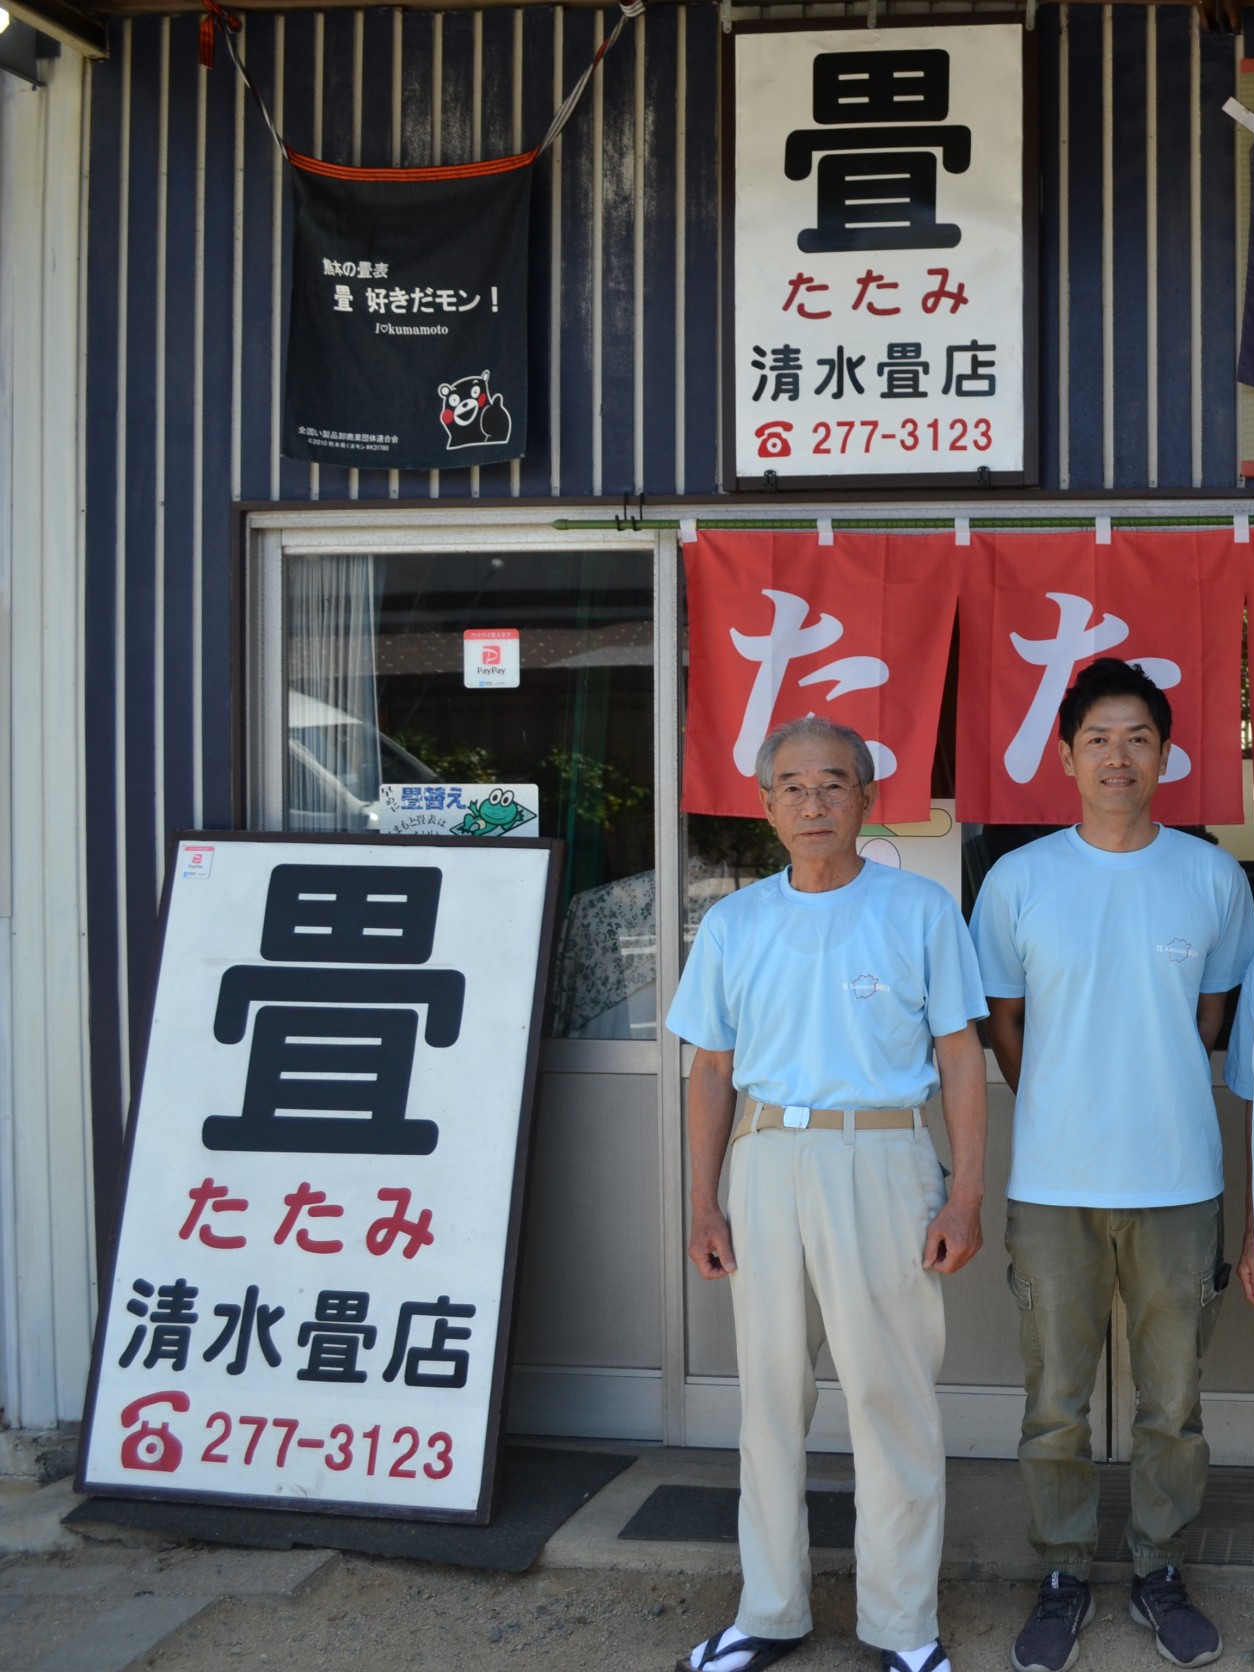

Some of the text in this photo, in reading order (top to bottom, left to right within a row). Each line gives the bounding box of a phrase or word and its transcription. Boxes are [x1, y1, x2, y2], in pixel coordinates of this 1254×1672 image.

[784, 49, 971, 253] 畳
[323, 257, 389, 279] 熊本の畳表
[782, 268, 969, 320] たたみ
[334, 285, 354, 312] 畳
[751, 340, 997, 401] 清水畳店
[812, 418, 993, 455] 277-3123
[477, 667, 506, 675] PayPay
[401, 787, 467, 811] 畳替え
[202, 863, 466, 1155] 畳
[179, 1177, 435, 1260] たたみ
[118, 1278, 476, 1389] 清水畳店
[201, 1410, 454, 1480] 277-3123
